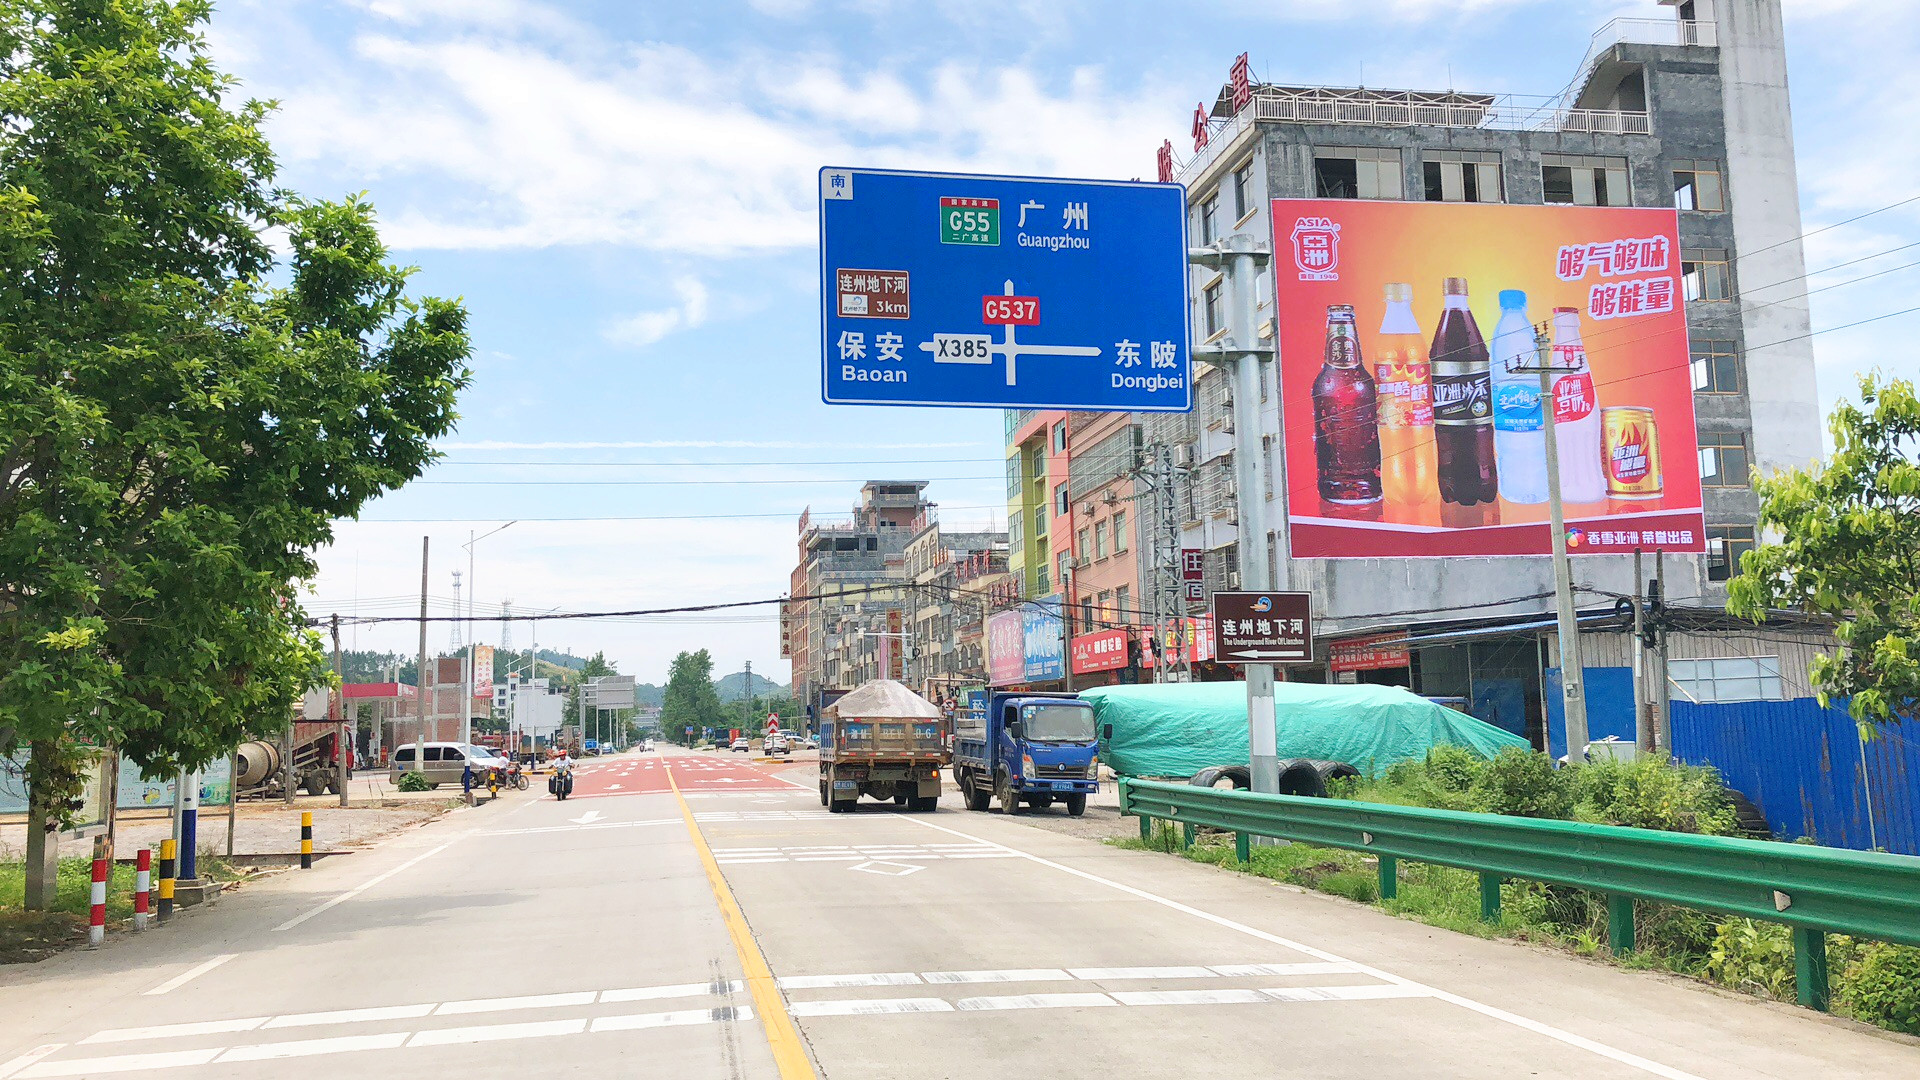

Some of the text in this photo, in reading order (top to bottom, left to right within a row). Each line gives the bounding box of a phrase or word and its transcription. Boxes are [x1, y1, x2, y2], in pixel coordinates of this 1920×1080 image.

[830, 174, 845, 188] 南
[951, 198, 988, 207] 国家高速
[949, 211, 990, 232] G55
[1018, 200, 1088, 231] 广州
[1296, 218, 1330, 228] ASIA
[952, 233, 989, 242] 二广高速
[1018, 232, 1090, 252] Guangzhou
[1558, 238, 1667, 278] 够气够味
[840, 274, 906, 295] 连州地下河
[876, 300, 907, 314] 3km
[1590, 279, 1672, 318] 够能量
[985, 300, 1036, 320] G537
[837, 330, 904, 361] 保安
[938, 339, 988, 358] X385
[1115, 339, 1178, 370] 东陂
[842, 365, 908, 383] Baoan
[1111, 372, 1183, 393] Dongbei
[1559, 379, 1582, 397] 亚洲
[1612, 444, 1640, 460] 亚洲
[1587, 530, 1693, 545] 香雪亚洲 荣誉出品
[1183, 552, 1203, 599] 住宿
[1222, 618, 1304, 636] 连州地下河
[1223, 637, 1233, 646] The
[1233, 637, 1265, 648] Underground
[1265, 637, 1277, 646] River
[1285, 637, 1305, 646] Lianzhou
